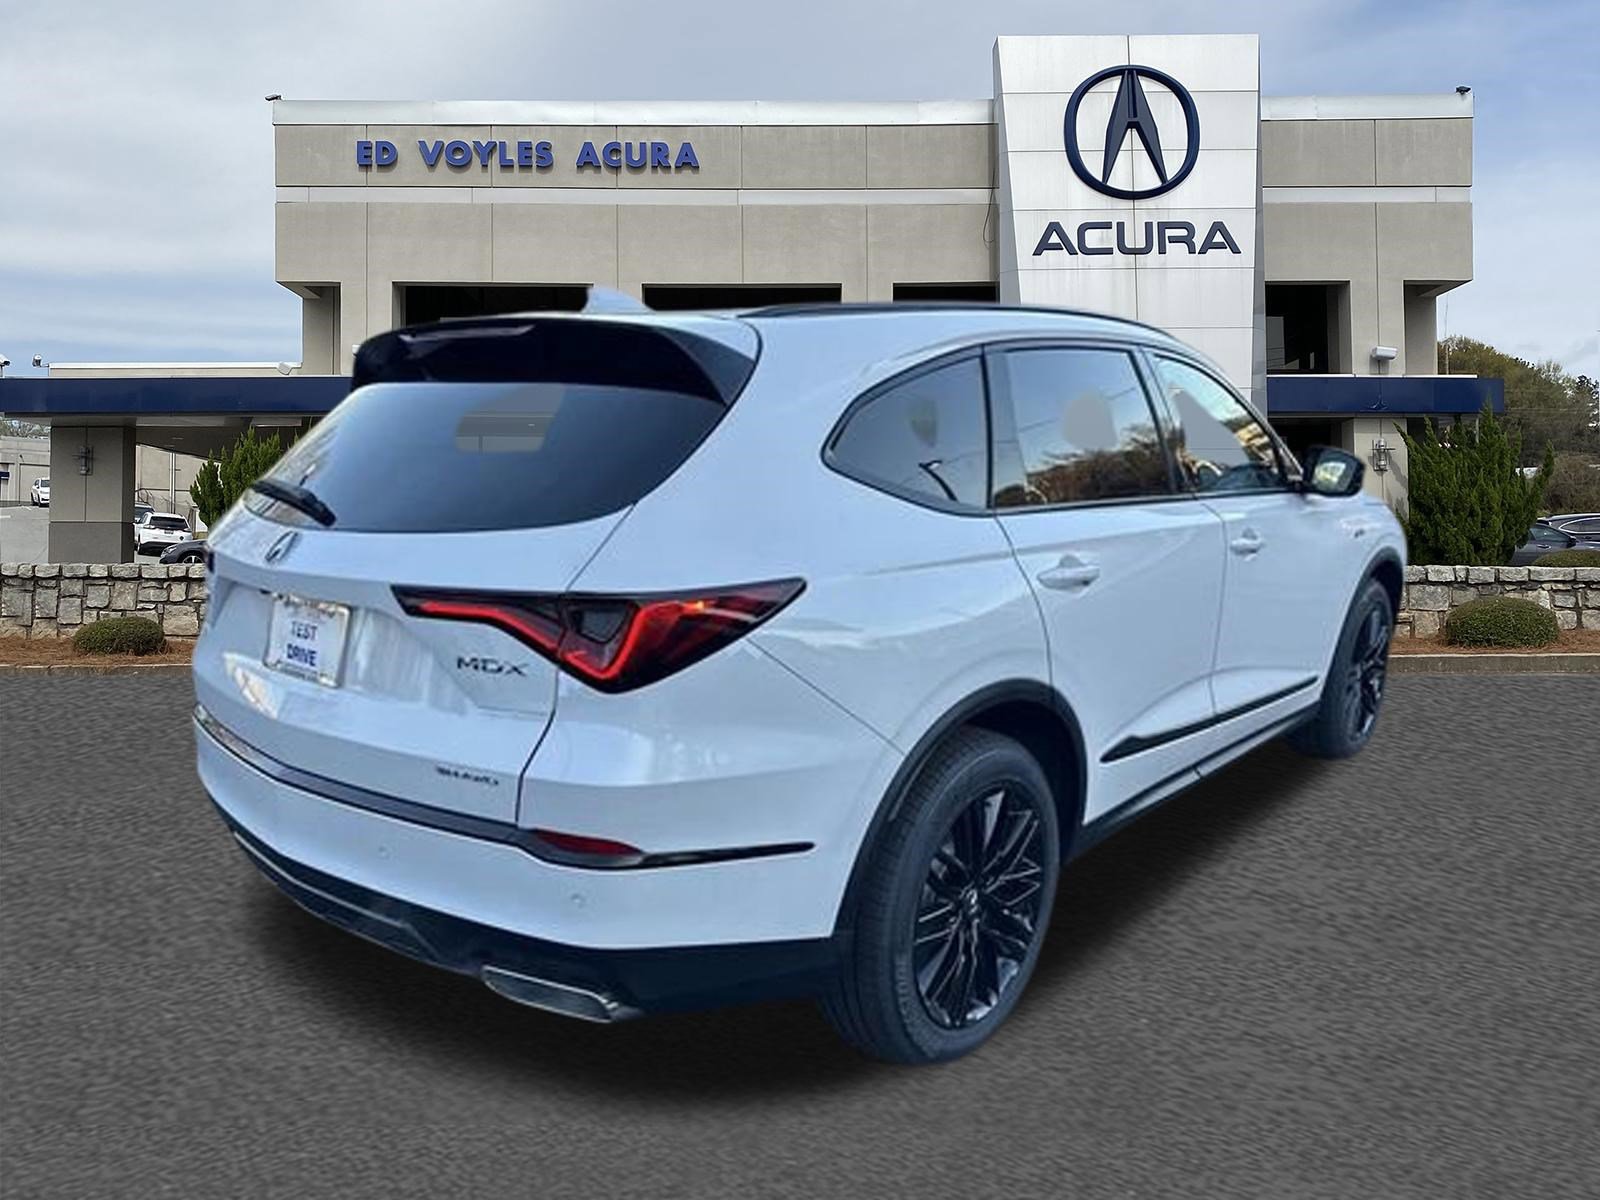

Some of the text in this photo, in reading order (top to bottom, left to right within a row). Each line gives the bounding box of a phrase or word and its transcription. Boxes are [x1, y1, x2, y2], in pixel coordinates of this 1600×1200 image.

[356, 140, 700, 169] ED VOYLES ACURA
[1032, 221, 1242, 256] ACURA
[291, 620, 318, 641] TEST
[286, 643, 317, 667] DRIVE
[457, 657, 529, 677] MDX
